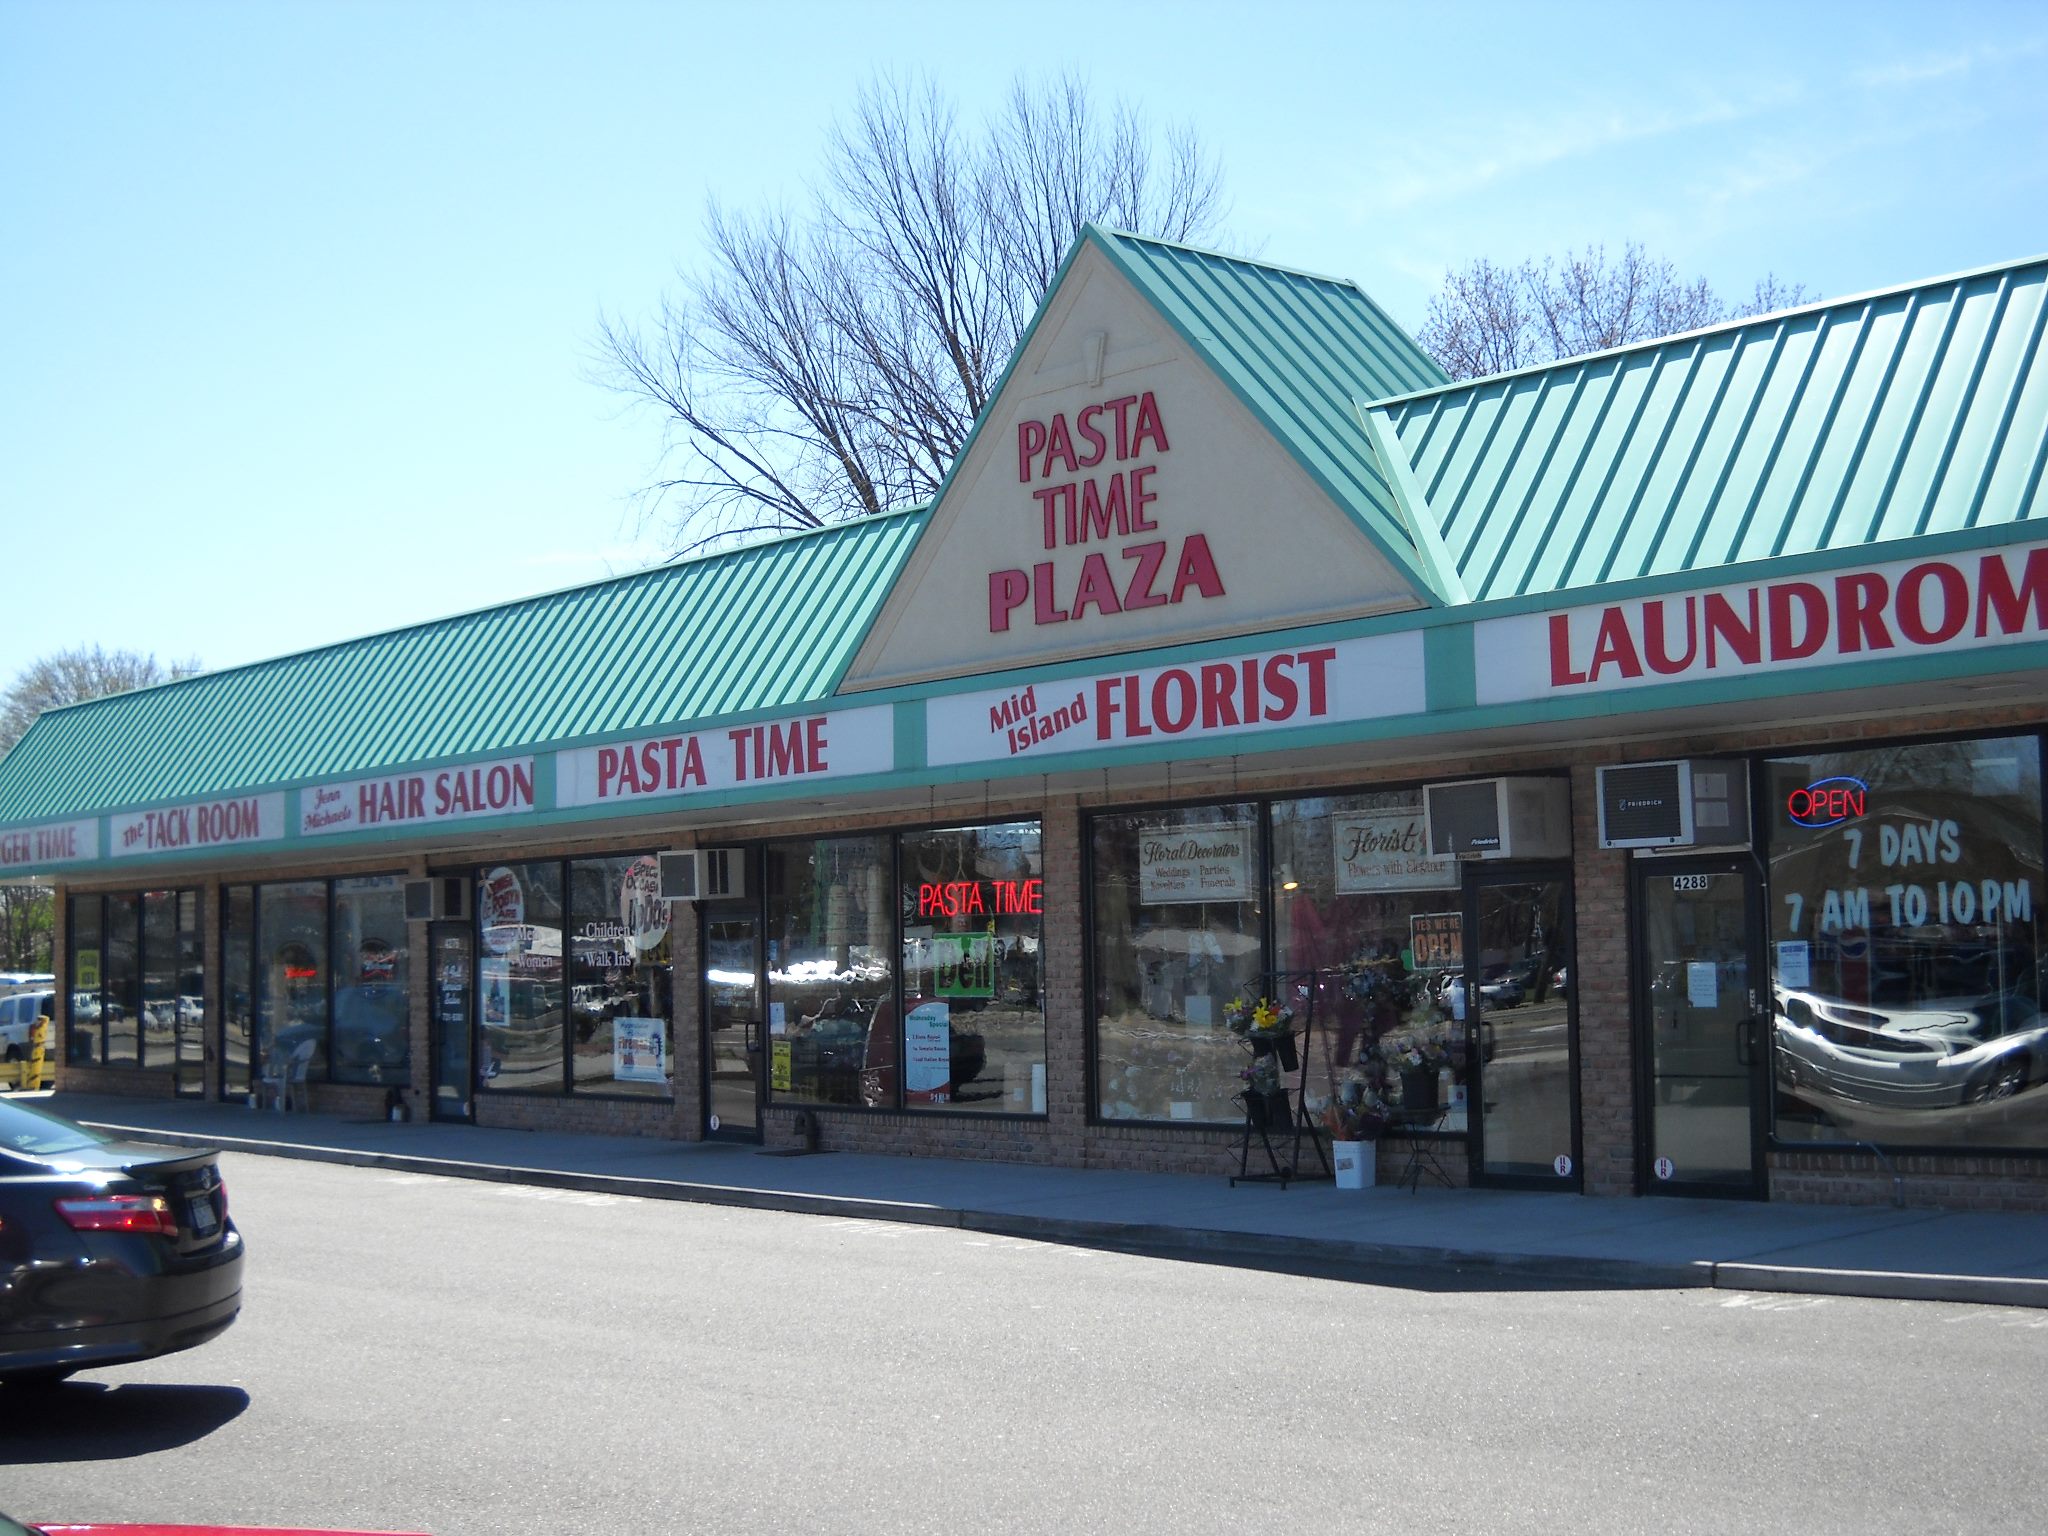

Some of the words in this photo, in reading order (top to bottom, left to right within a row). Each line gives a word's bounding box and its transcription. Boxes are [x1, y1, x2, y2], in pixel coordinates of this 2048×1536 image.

[1018, 391, 1169, 483] PASTA
[1033, 465, 1157, 549] TIME
[989, 533, 1226, 632] PLAZA
[989, 685, 1036, 733] Mid
[1096, 647, 1336, 741] FLORIST
[1007, 692, 1088, 755] Island
[598, 736, 706, 797] PASTA
[728, 717, 828, 781] TIME
[358, 777, 425, 824] HAIR
[435, 761, 534, 816] SALON
[1788, 789, 1865, 817] OPEN
[36, 826, 76, 860] TIME
[123, 822, 144, 847] the
[145, 808, 190, 849] TACK
[197, 799, 259, 843] ROOM
[1343, 822, 1419, 862] Florist
[1143, 841, 1187, 866] Floral
[1187, 840, 1240, 860] Decorators
[1844, 828, 1863, 869] 7
[1880, 819, 1960, 867] DAYS
[1155, 867, 1190, 879] Weddings
[1200, 864, 1230, 876] Parties
[1200, 876, 1236, 889] Funerals
[1383, 860, 1403, 875] with
[1674, 874, 1707, 889] 4288
[919, 881, 983, 916] PASTA
[992, 880, 1043, 913] TIME
[1785, 892, 1804, 933] 7
[1821, 887, 1870, 932] AM
[1886, 884, 1927, 927] TO
[1981, 878, 2031, 924] PM
[586, 922, 631, 938] Children
[1415, 919, 1431, 931] YES
[518, 954, 553, 968] Women
[586, 951, 611, 967] Walk
[1414, 932, 1462, 962] OPEN
